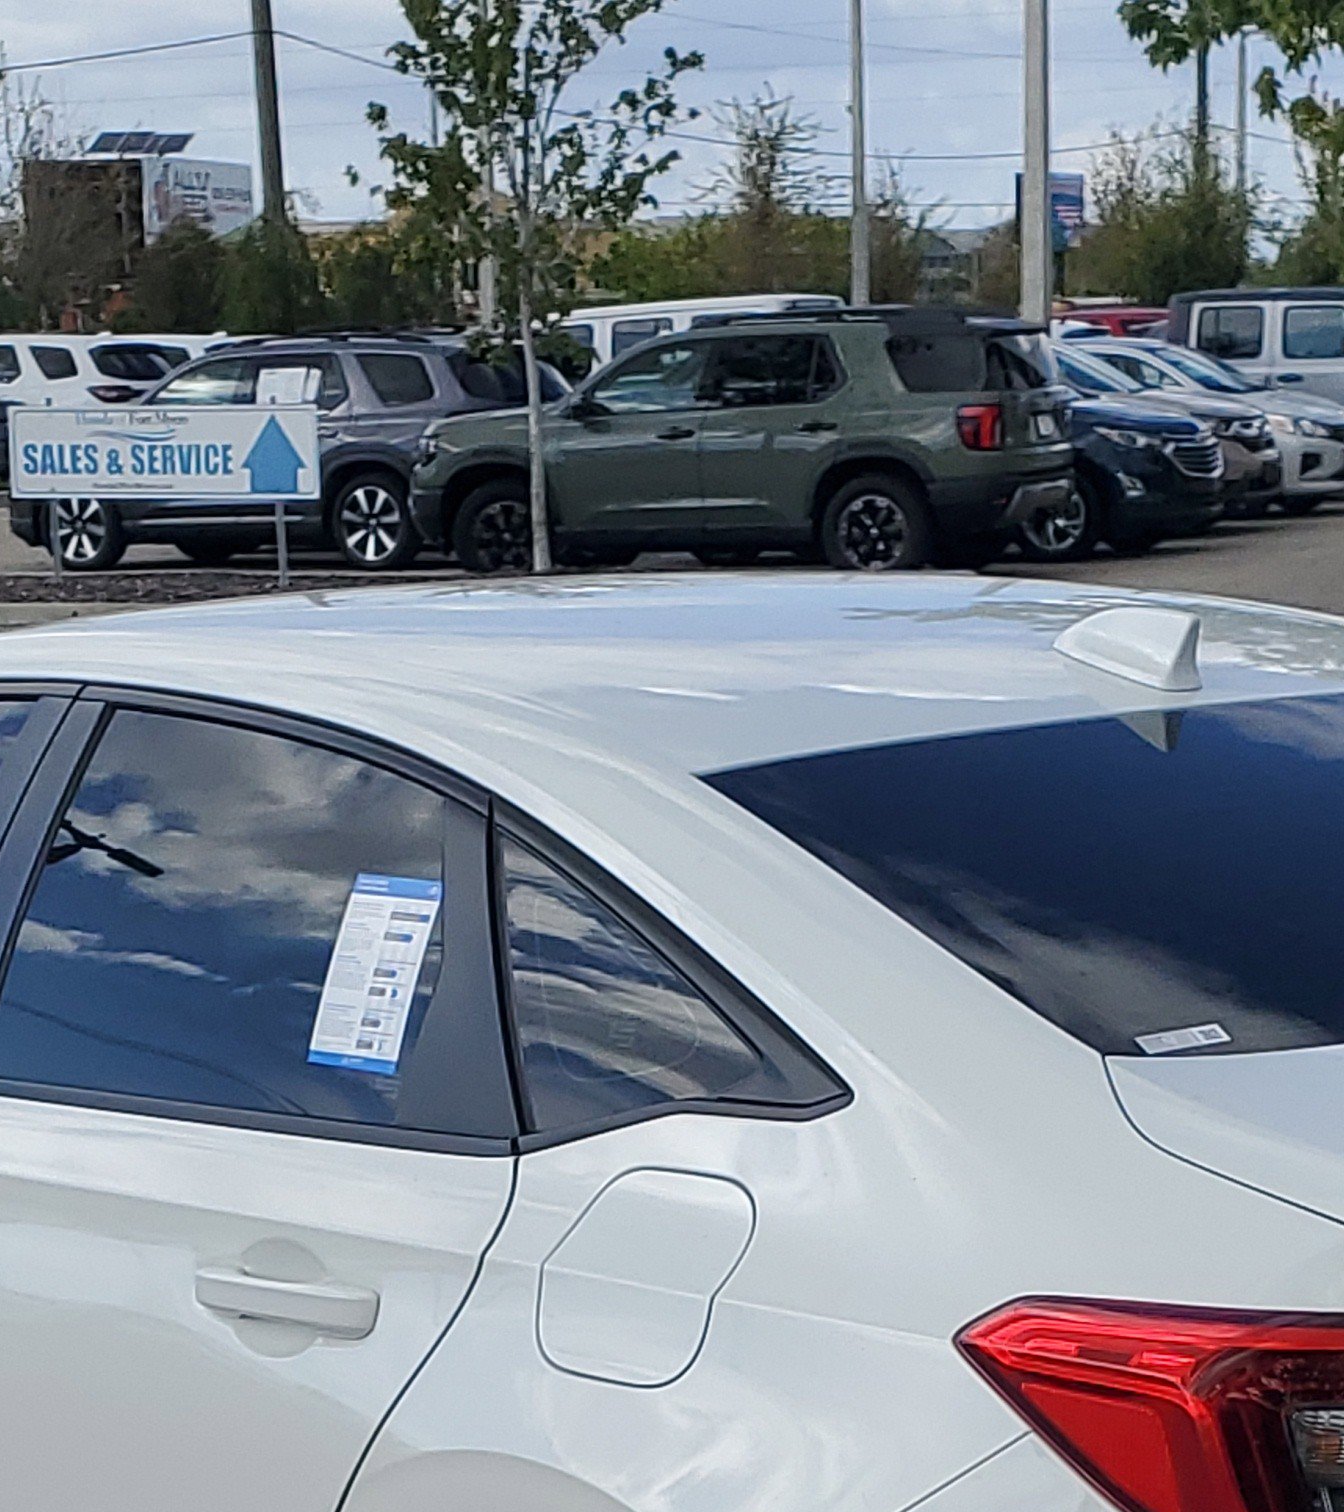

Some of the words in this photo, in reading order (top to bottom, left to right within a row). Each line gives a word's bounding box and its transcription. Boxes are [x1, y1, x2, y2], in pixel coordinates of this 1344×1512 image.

[22, 443, 99, 475] SALES
[106, 447, 124, 475] &
[131, 443, 234, 475] SERVICE
